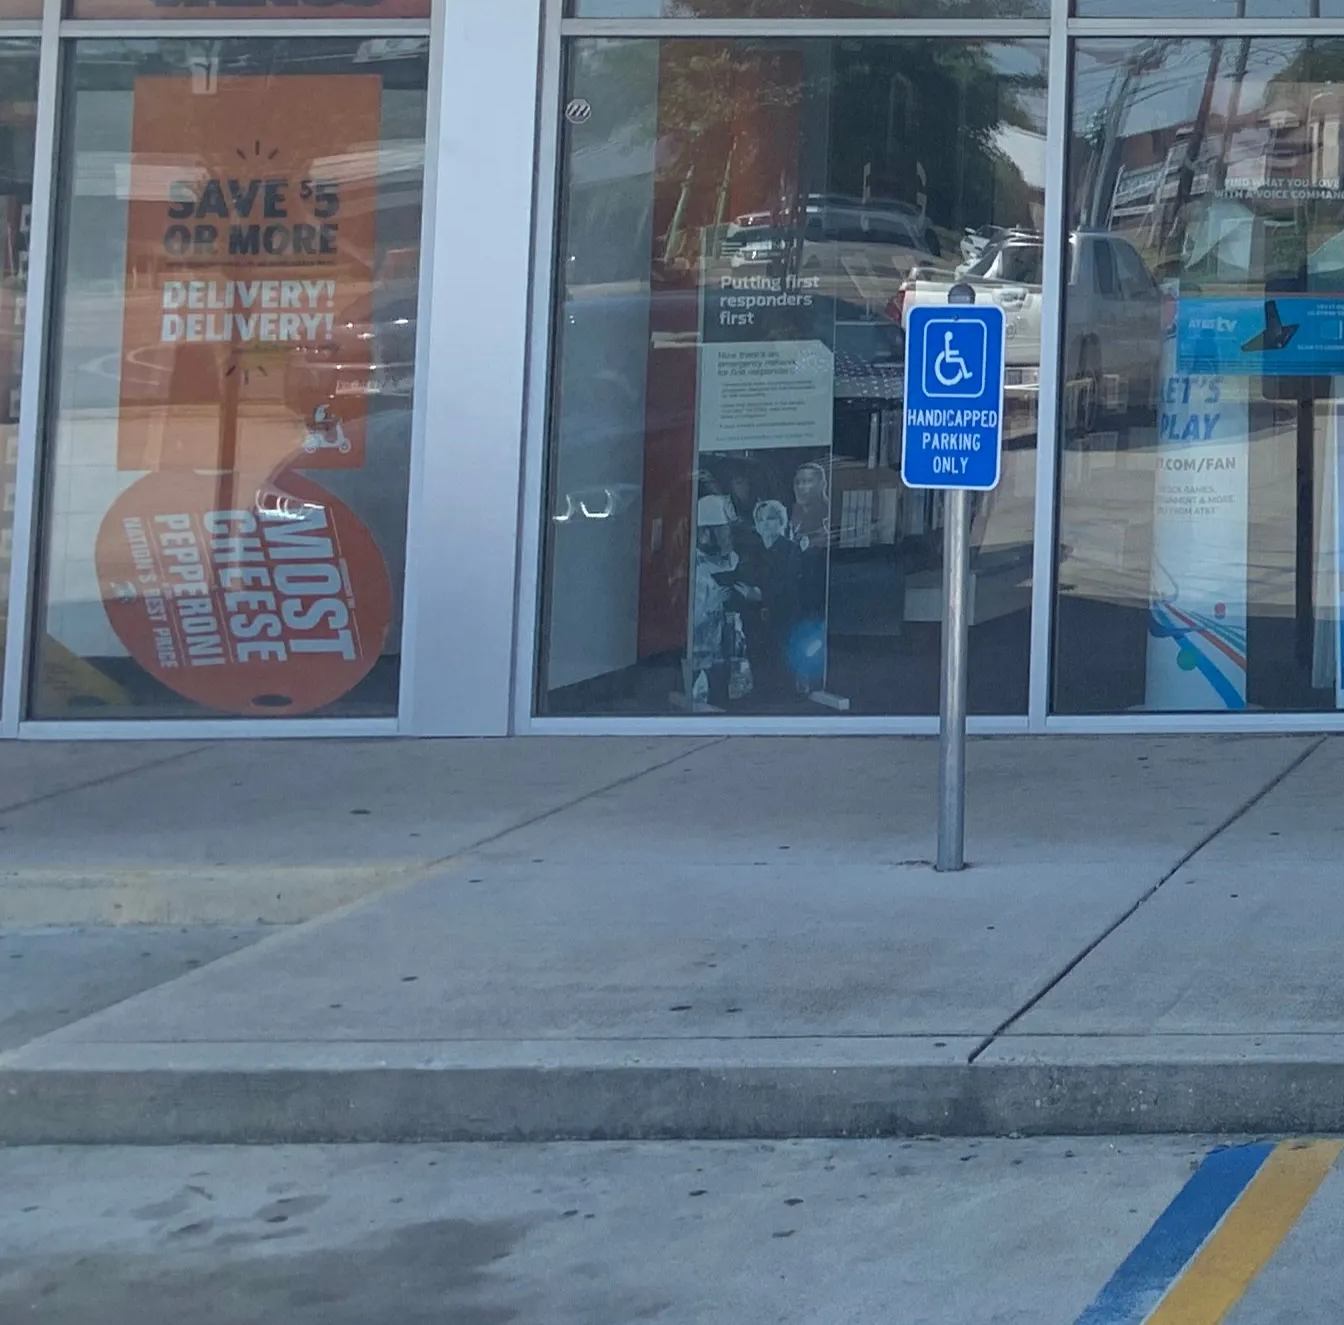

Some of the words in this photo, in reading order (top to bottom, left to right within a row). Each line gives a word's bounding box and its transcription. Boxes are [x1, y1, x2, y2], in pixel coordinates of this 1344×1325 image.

[1250, 177, 1285, 187] WHAT
[1286, 177, 1310, 187] YOU
[167, 179, 289, 219] SAVE
[299, 179, 341, 219] $5
[1214, 190, 1243, 199] WITH
[1256, 190, 1289, 199] VOICE
[163, 223, 219, 256] OR
[228, 223, 339, 256] MORE
[720, 276, 781, 291] Putting
[786, 275, 820, 289] first
[162, 279, 336, 309] DELIVERY!
[719, 293, 813, 308] responders
[160, 312, 334, 342] DELIVERY!
[719, 311, 754, 325] first
[907, 409, 998, 427] HANDICAPPED
[922, 432, 981, 451] PARKING
[932, 456, 969, 474] ONLY
[154, 513, 227, 666] PEPPERONI
[203, 509, 288, 662] CHEESE
[258, 507, 357, 661] MOST
